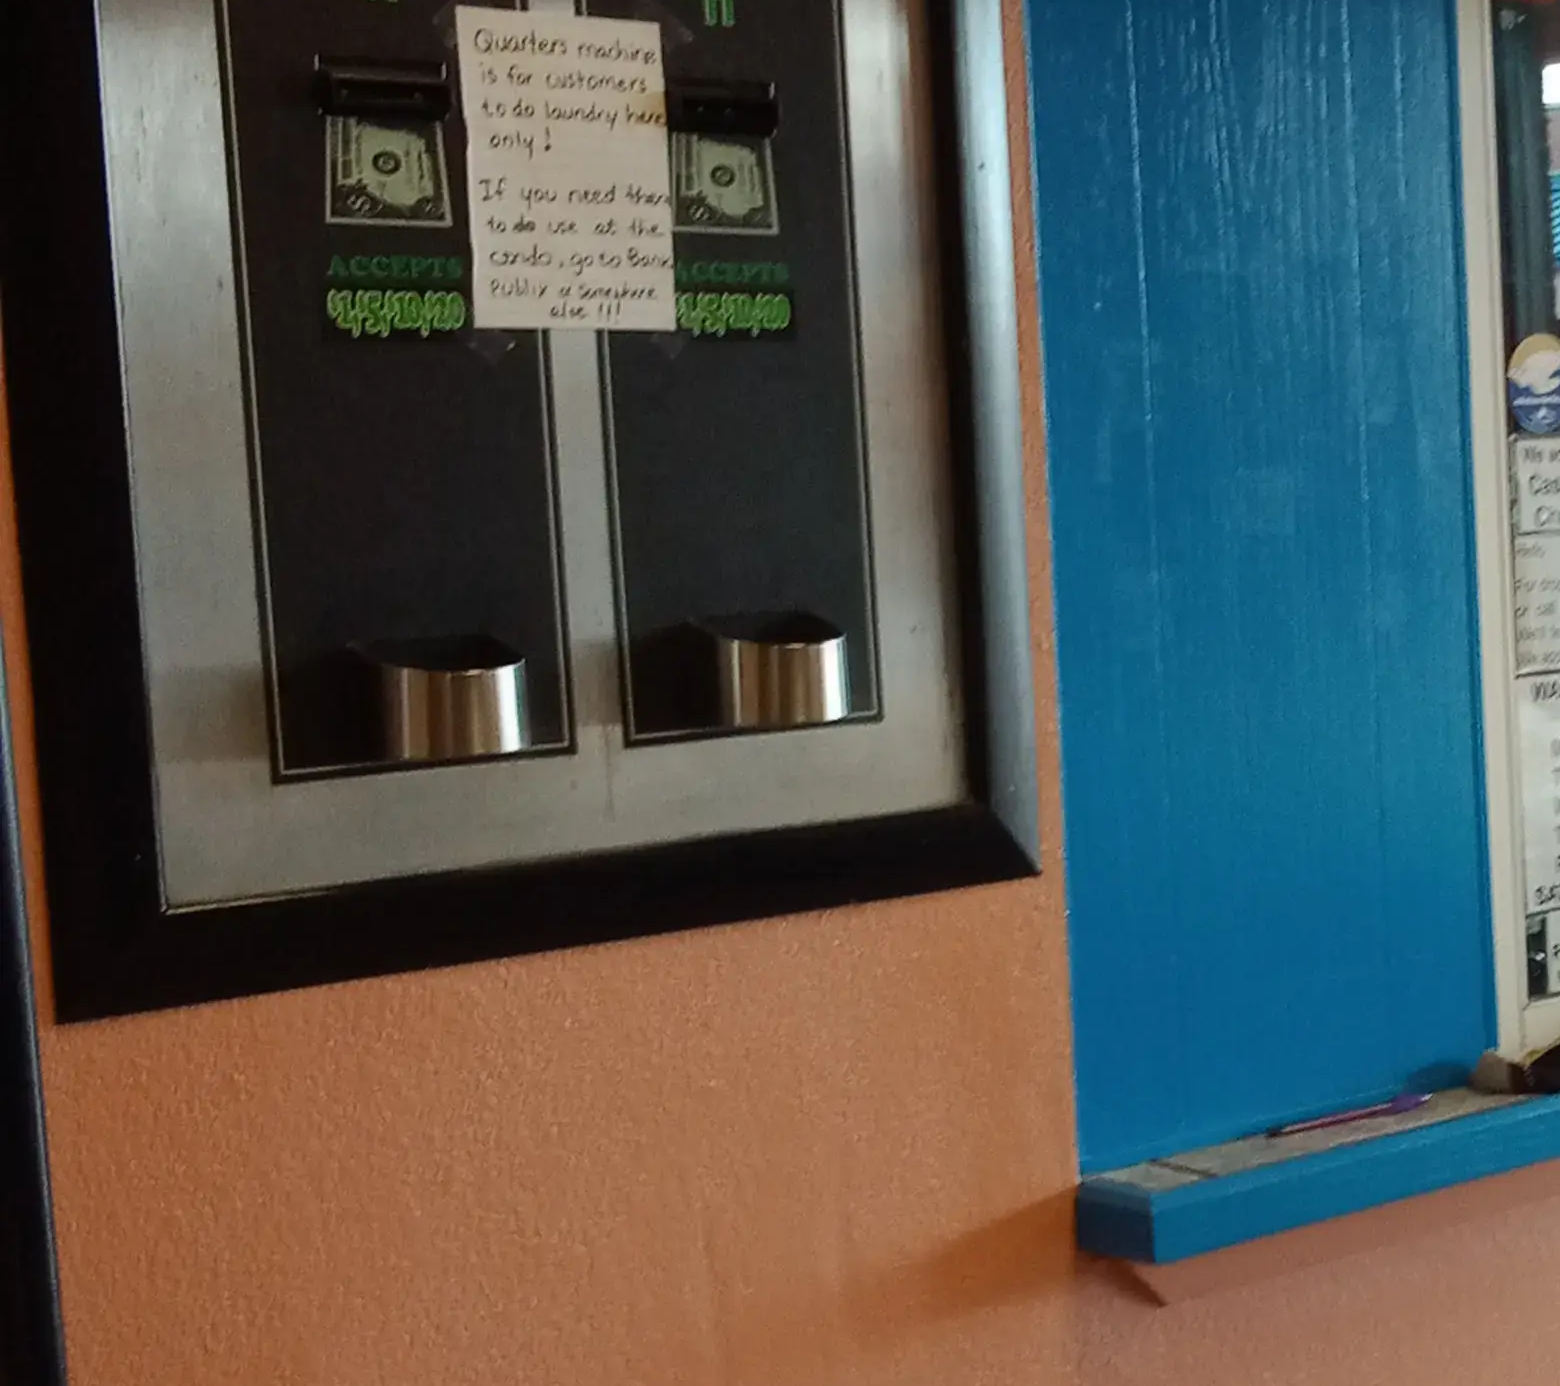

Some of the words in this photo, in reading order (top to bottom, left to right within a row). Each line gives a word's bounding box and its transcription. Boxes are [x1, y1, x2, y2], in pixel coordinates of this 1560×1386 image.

[474, 27, 569, 57] Quarters
[577, 37, 657, 64] machine
[480, 62, 498, 84] is
[506, 64, 533, 86] for
[545, 69, 647, 94] customers
[481, 96, 507, 119] to
[512, 97, 535, 118] do
[544, 100, 618, 131] laundry
[626, 103, 668, 127] here
[478, 177, 507, 202] If
[520, 186, 557, 210] you
[568, 181, 617, 204] need
[485, 215, 506, 233] to
[548, 220, 579, 235] use
[628, 217, 665, 238] the
[326, 254, 464, 280] ACCEPTS
[570, 254, 594, 276] go
[599, 253, 621, 270] to
